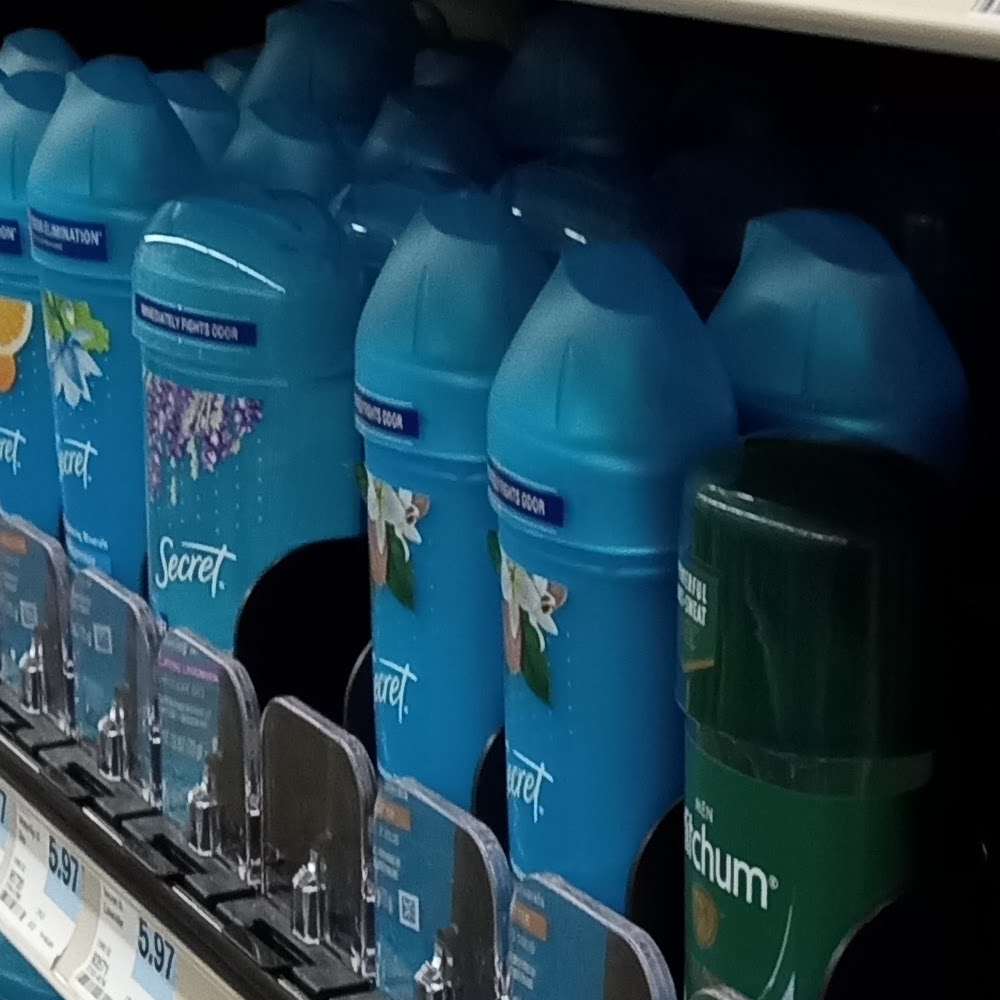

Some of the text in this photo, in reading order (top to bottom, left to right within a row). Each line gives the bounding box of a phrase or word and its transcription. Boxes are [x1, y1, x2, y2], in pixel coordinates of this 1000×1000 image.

[211, 323, 239, 342] ODOR
[382, 408, 404, 431] ODOR
[521, 495, 546, 517] ODOR
[48, 834, 80, 894] 5.97
[137, 916, 176, 981] 5.97
